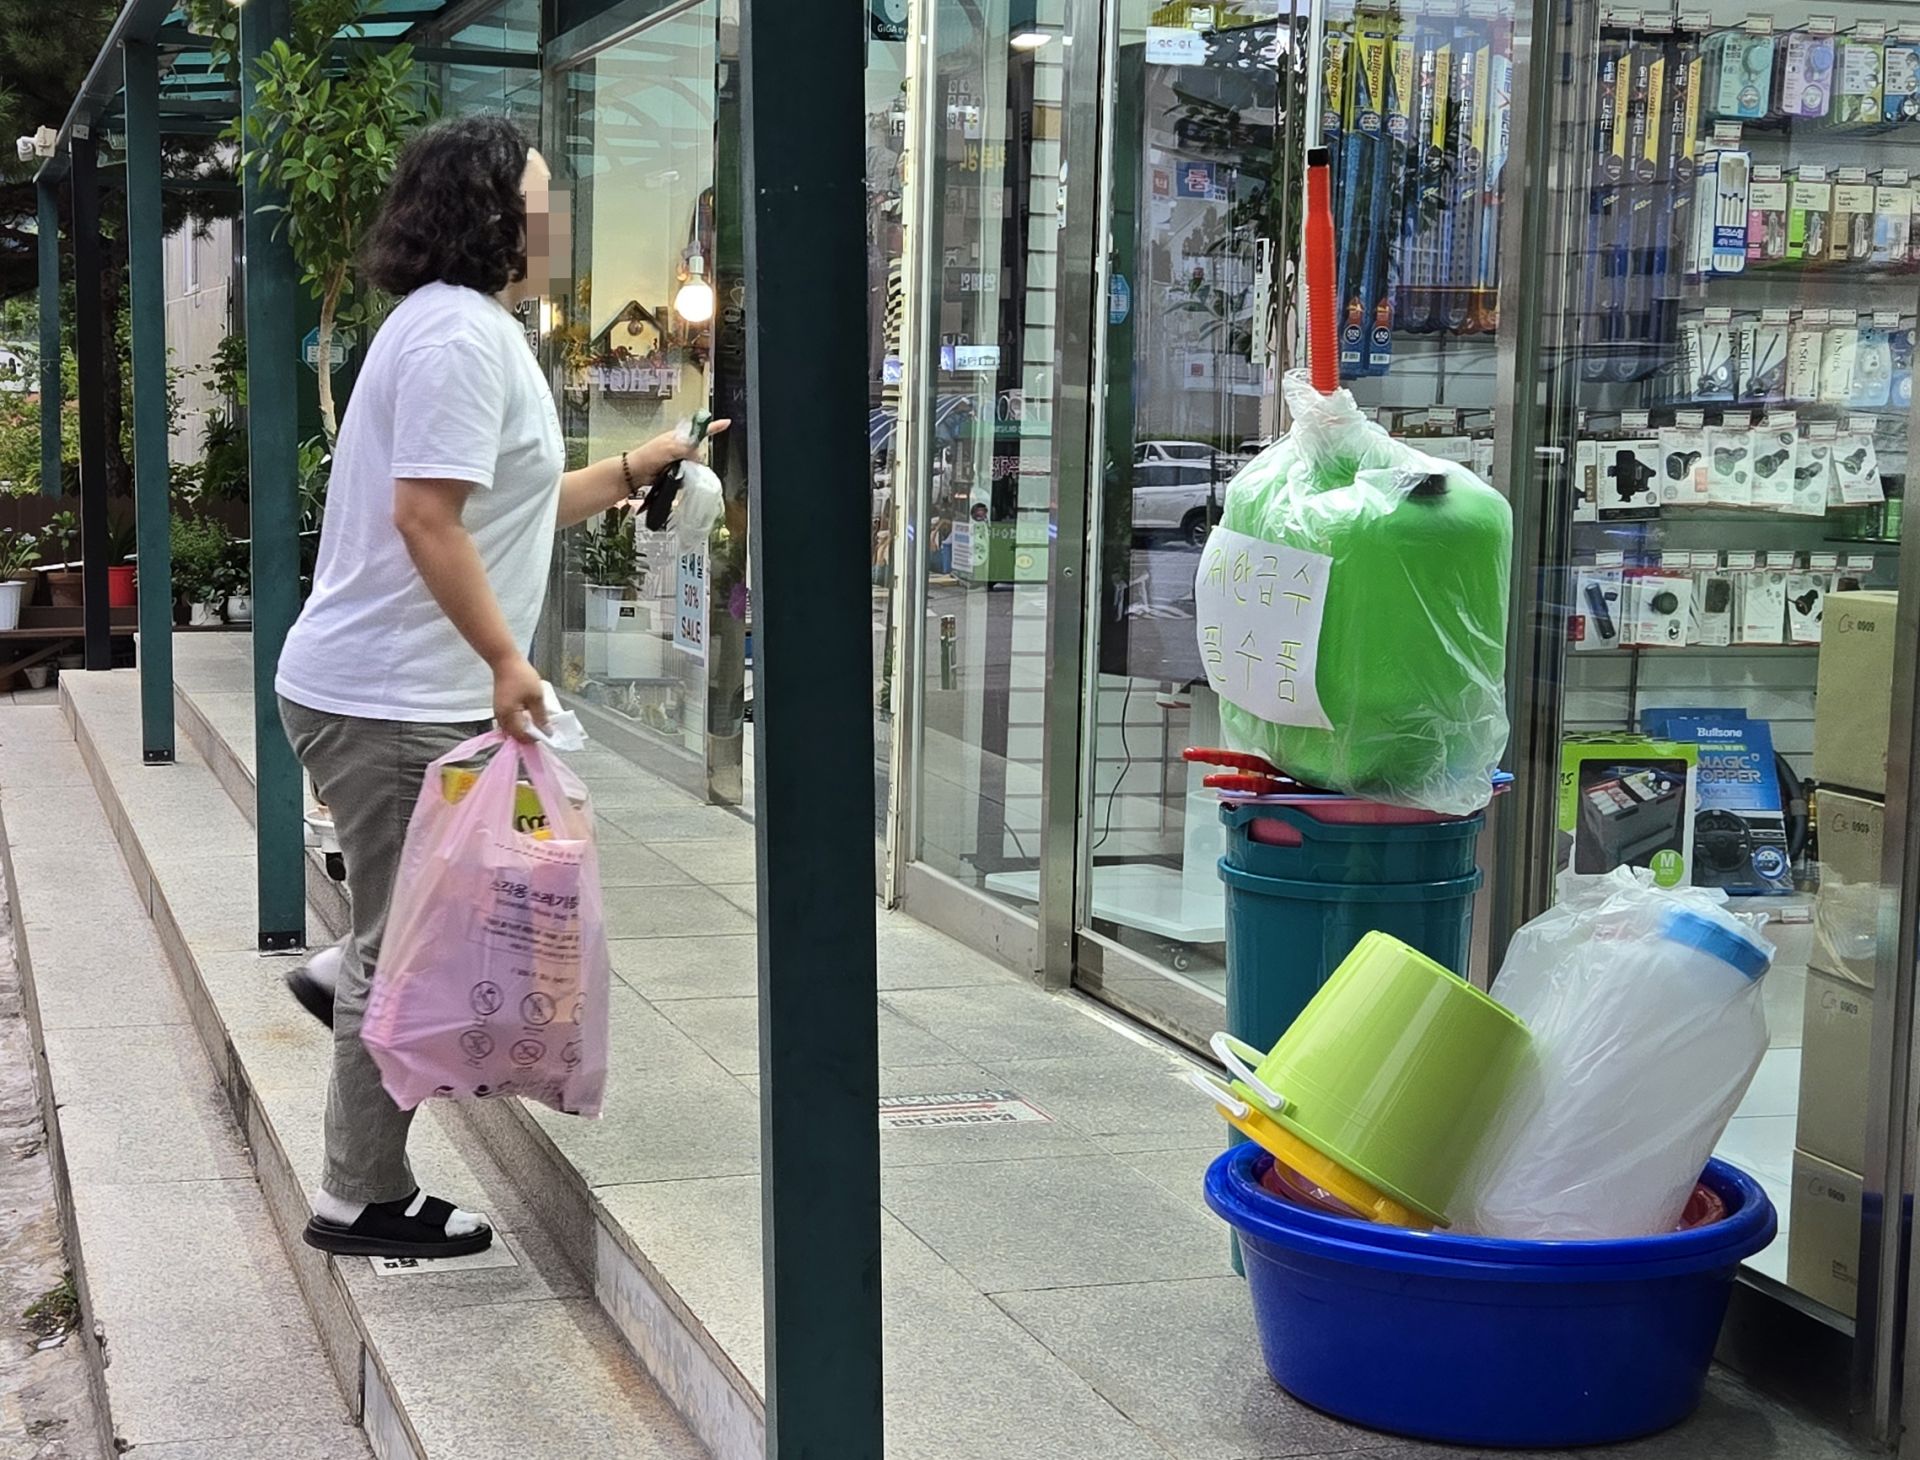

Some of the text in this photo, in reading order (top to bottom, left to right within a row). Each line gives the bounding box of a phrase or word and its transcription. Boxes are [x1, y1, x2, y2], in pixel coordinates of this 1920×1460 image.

[1371, 44, 1383, 98] Bullsone
[1203, 548, 1312, 617] 제한급수
[681, 616, 701, 644] SALE
[1696, 727, 1743, 738] Bullsone
[1697, 755, 1751, 769] MAGIC
[1697, 769, 1762, 784] OPPER
[1660, 852, 1675, 868] M
